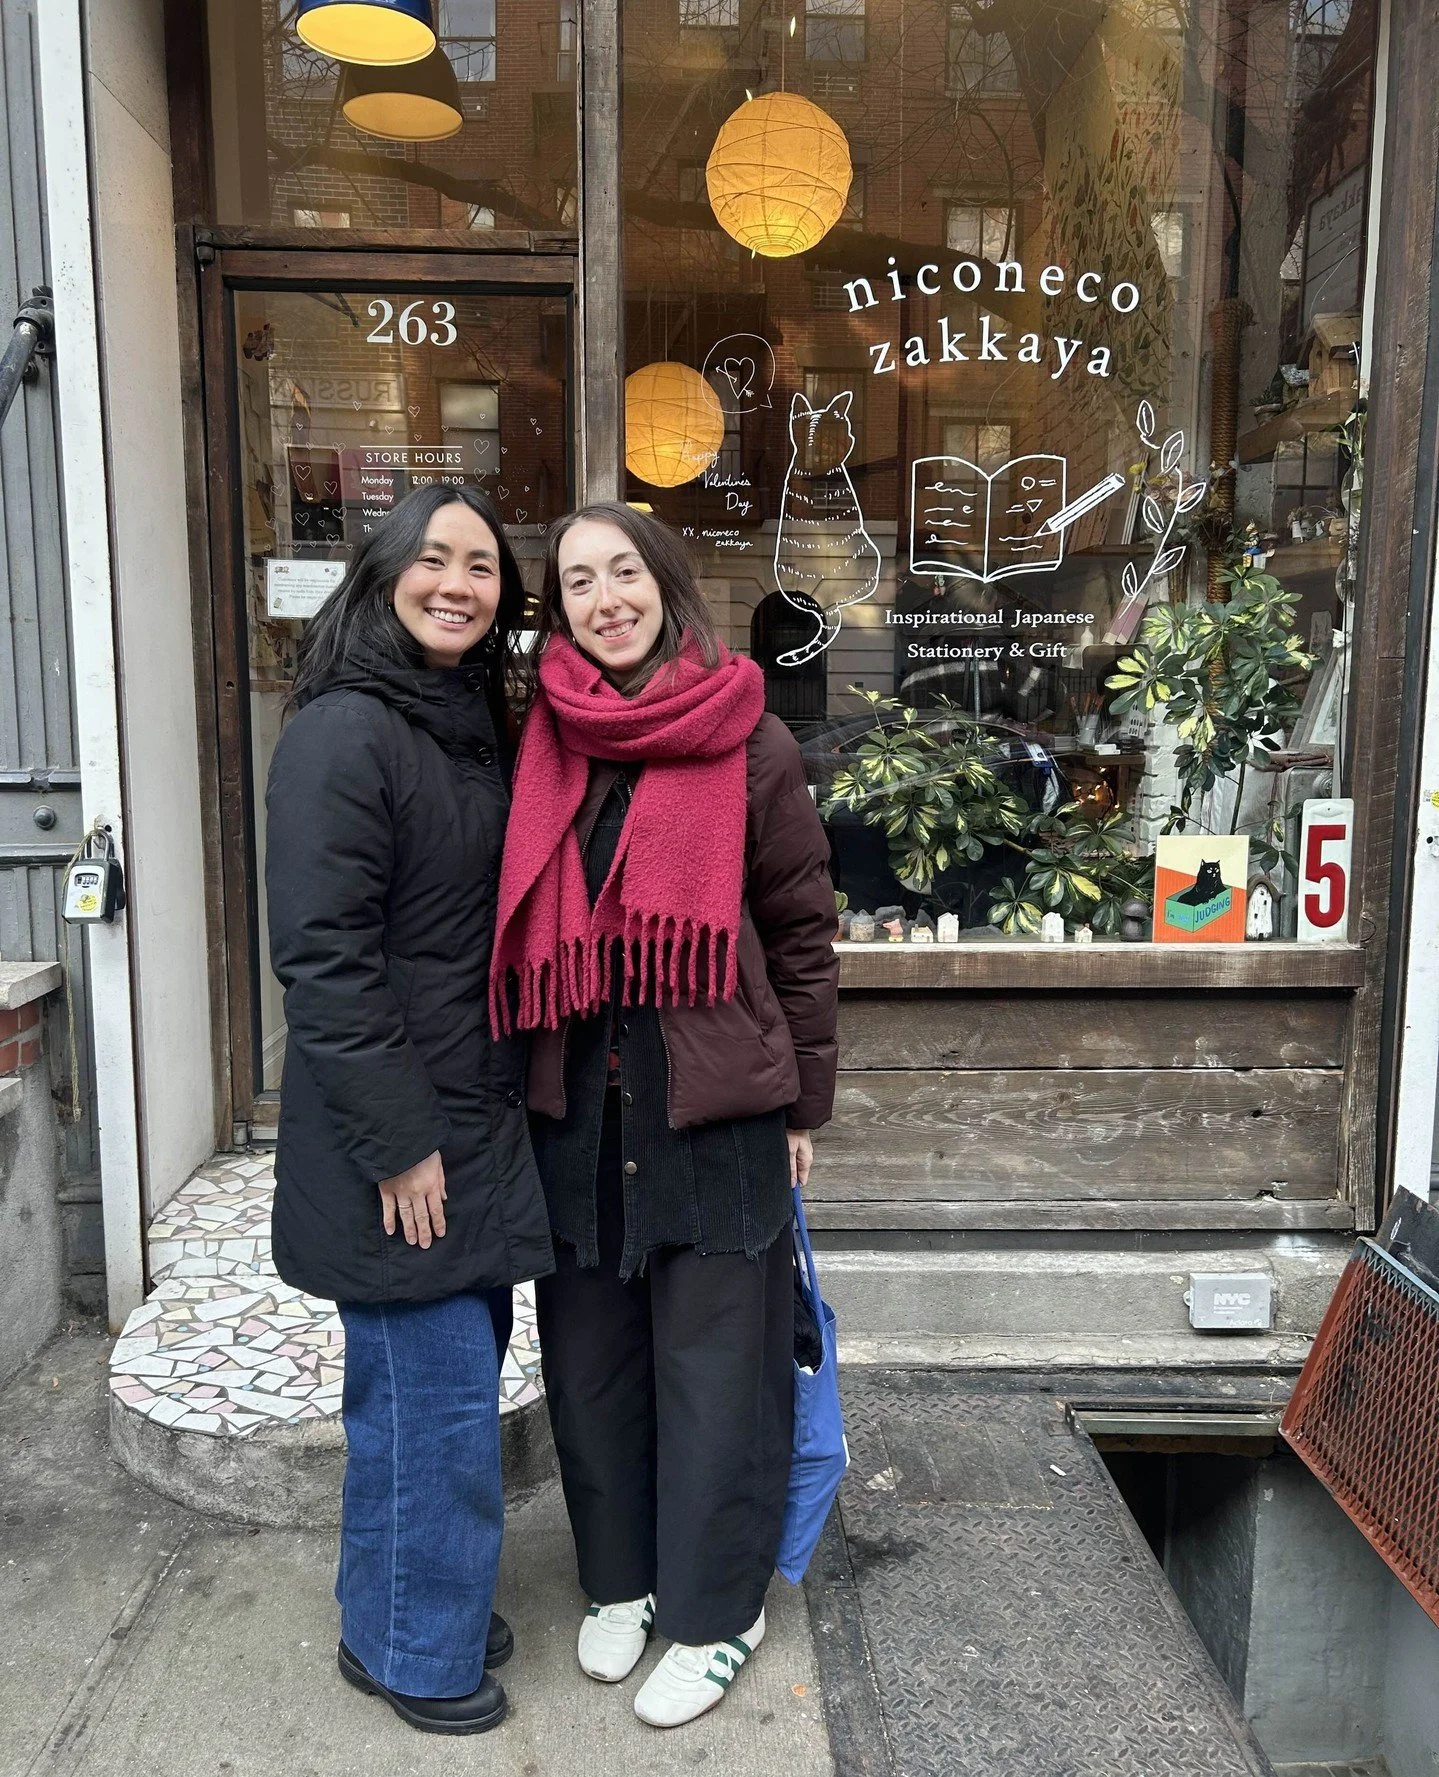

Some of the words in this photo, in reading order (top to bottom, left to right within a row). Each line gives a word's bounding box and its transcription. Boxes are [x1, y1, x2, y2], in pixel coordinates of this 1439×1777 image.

[842, 256, 1140, 314] niconeco
[366, 299, 458, 346] 263
[869, 315, 1113, 379] zakkaya
[365, 452, 408, 463] STORE
[415, 452, 462, 463] HOURS
[361, 474, 394, 487] Monday
[412, 475, 433, 485] 12:00
[362, 491, 394, 503] Tuesday
[725, 491, 753, 516] Day
[884, 609, 1004, 628] Inspirational
[1011, 609, 1095, 628] Japanese
[907, 643, 1005, 661] Stationery
[1009, 643, 1025, 658] &
[1029, 642, 1068, 658] Gift
[1304, 824, 1347, 928] 5
[1195, 896, 1231, 923] JUDGING
[1213, 1293, 1251, 1306] NYC
